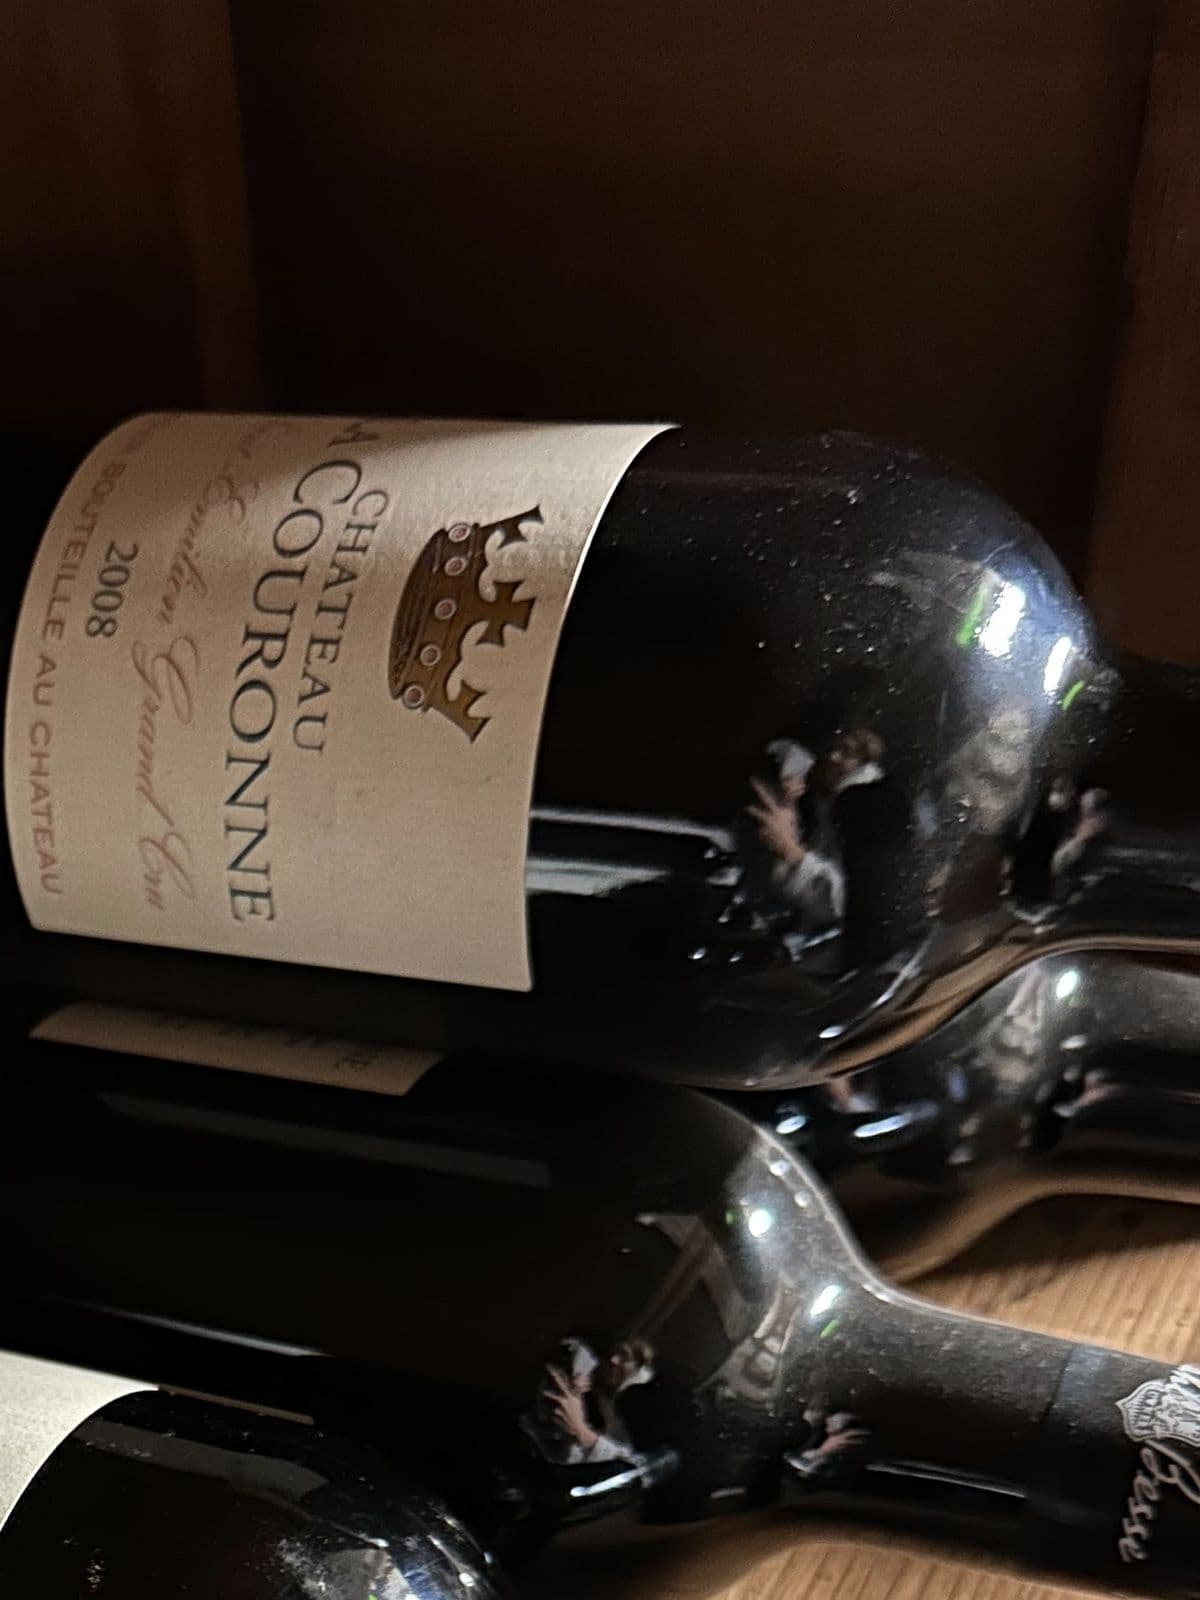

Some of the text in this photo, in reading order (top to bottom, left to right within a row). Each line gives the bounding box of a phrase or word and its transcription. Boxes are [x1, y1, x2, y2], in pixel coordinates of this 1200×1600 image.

[28, 461, 127, 895] BOUTEILLE AU CHATEAU
[85, 541, 139, 639] 2008
[293, 489, 389, 755] CHATEAU
[131, 636, 200, 826] Grand
[224, 459, 363, 923] COURONNE
[137, 832, 195, 911] Cru
[1117, 1437, 1200, 1564] Besse
